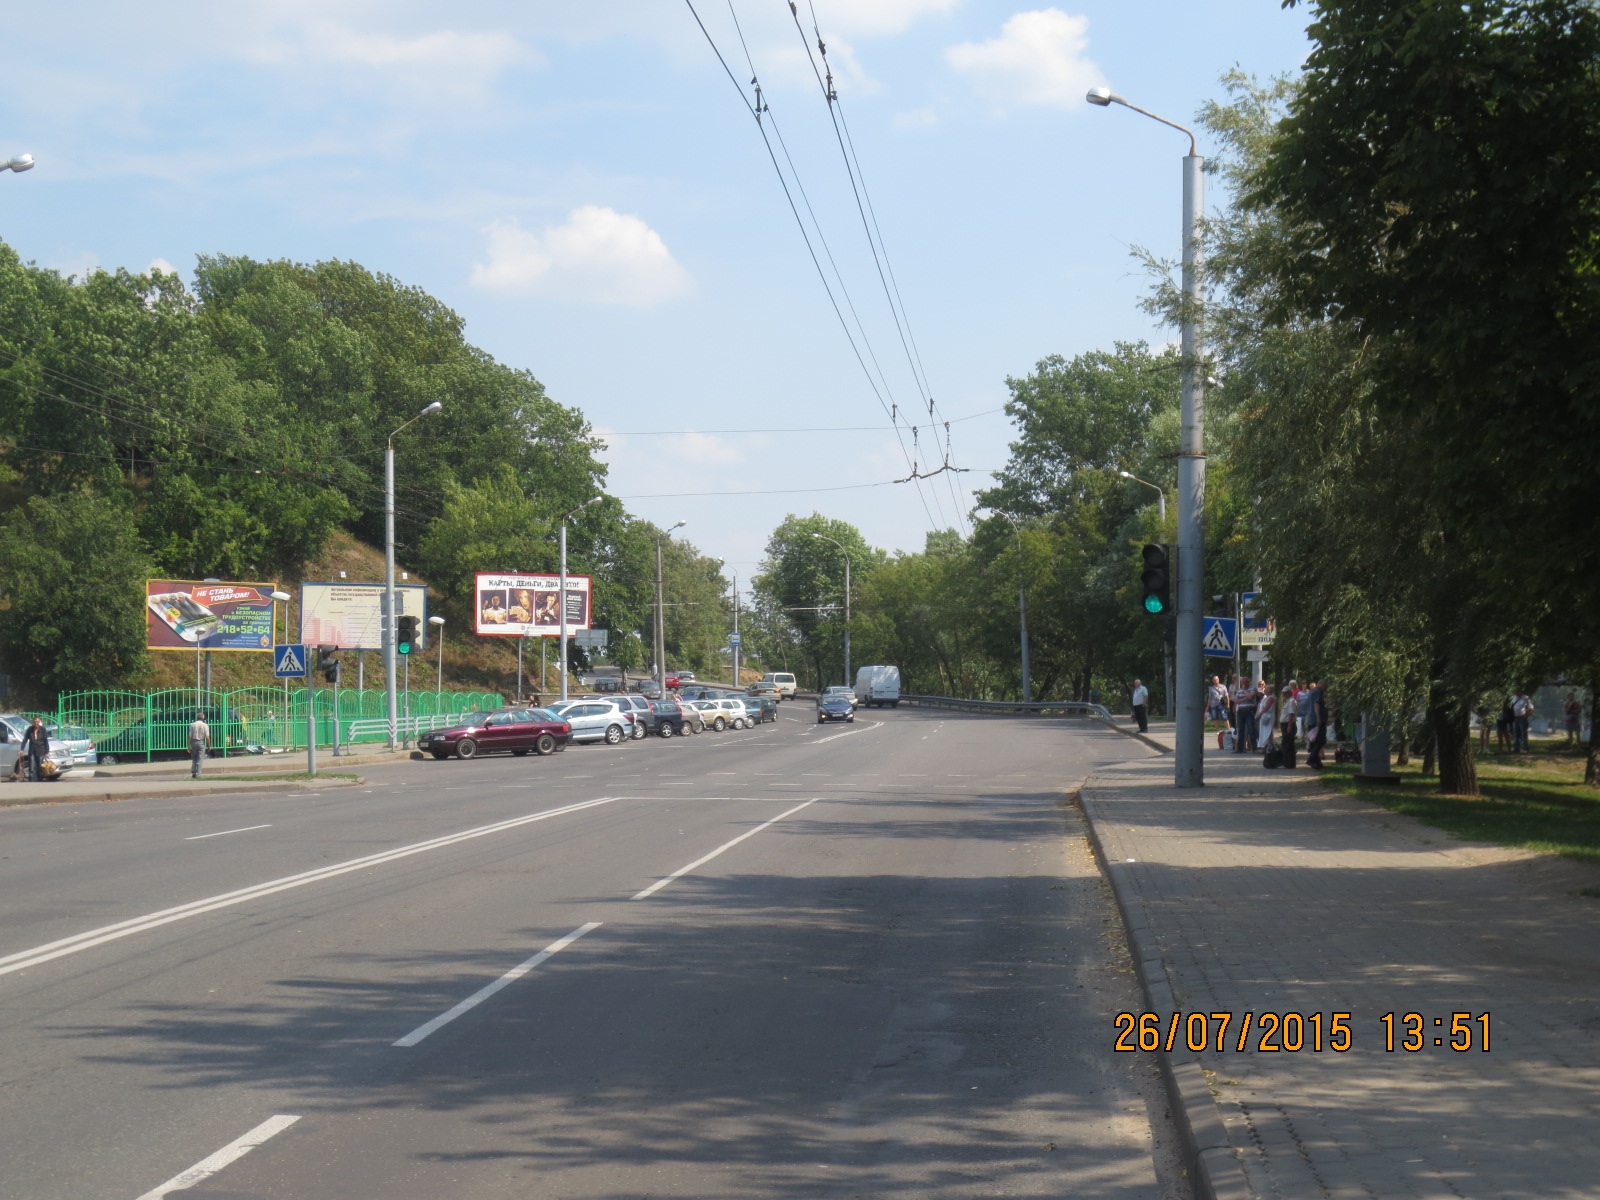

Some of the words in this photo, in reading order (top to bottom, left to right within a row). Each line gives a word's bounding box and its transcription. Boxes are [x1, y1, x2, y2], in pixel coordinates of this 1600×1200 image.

[488, 580, 514, 588] КАРТЫ,
[516, 580, 544, 588] ДЕНЬГИ,
[209, 588, 233, 596] СТАНЬ
[210, 591, 250, 602] ТОВАРОМ!
